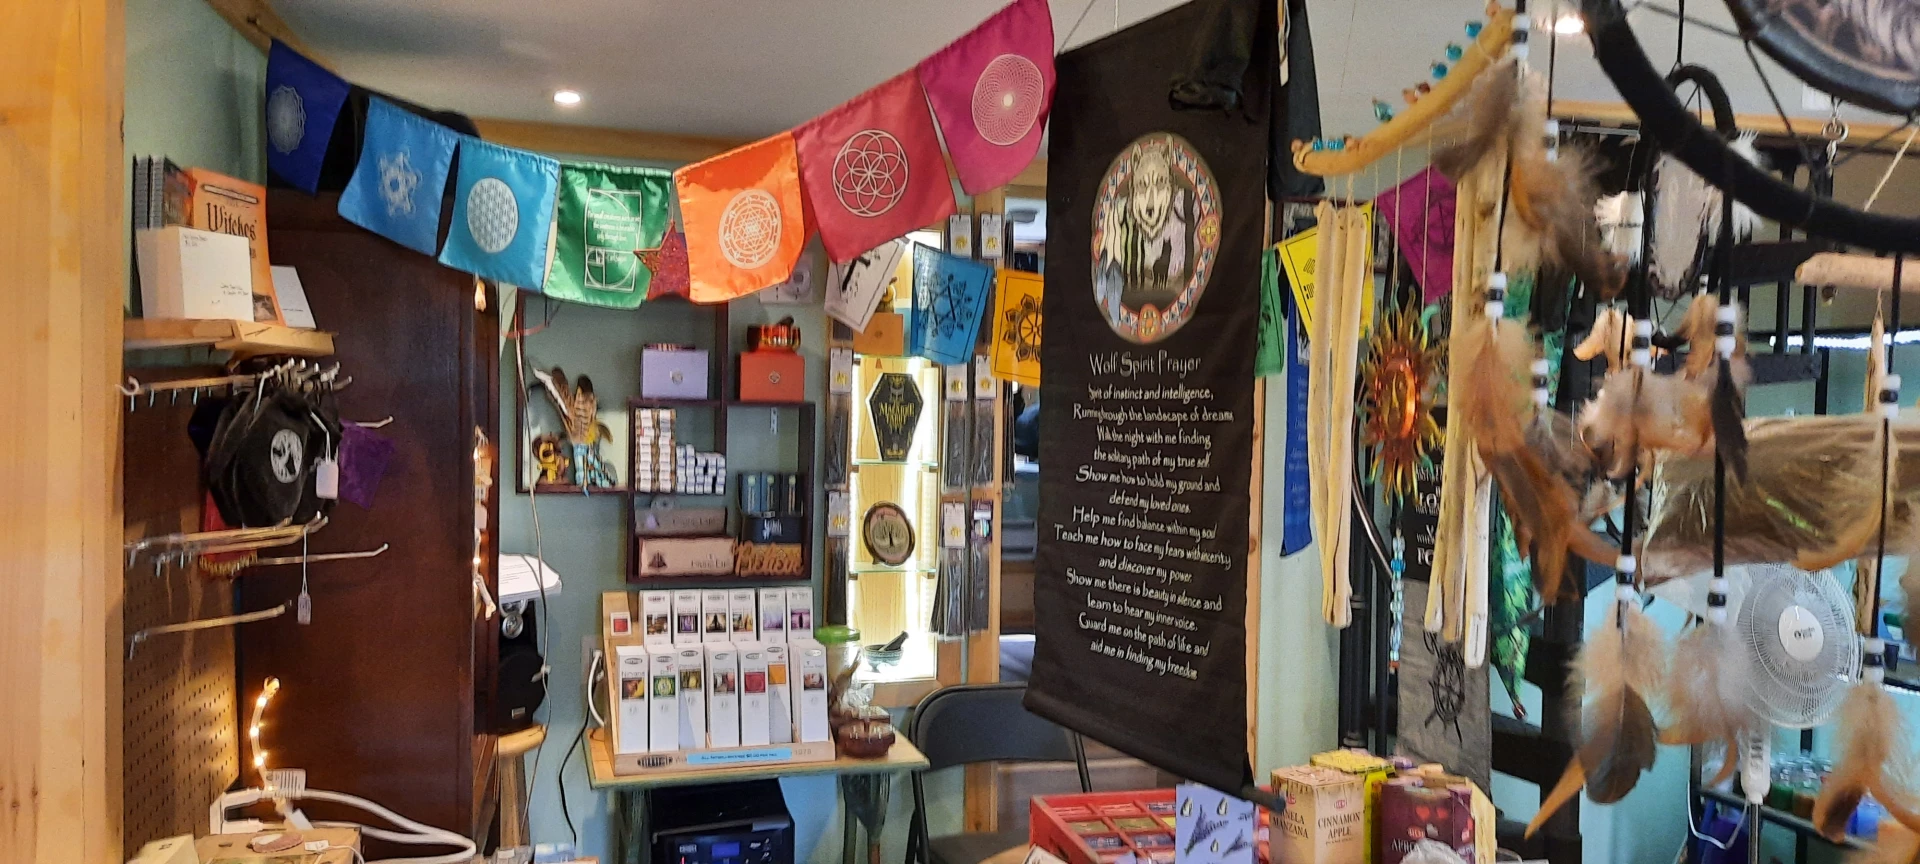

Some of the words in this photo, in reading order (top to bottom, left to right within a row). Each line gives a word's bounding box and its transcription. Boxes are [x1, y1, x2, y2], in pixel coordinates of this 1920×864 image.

[1089, 351, 1118, 376] Wolf
[1120, 350, 1155, 381] Spirit
[1158, 349, 1201, 379] Prayer
[1103, 383, 1113, 400] of
[1113, 386, 1143, 400] instinct
[1143, 382, 1161, 400] and
[1161, 382, 1214, 405] intelligence,
[1128, 405, 1143, 421] the
[1142, 405, 1189, 427] landscape
[1190, 405, 1200, 421] of
[1111, 426, 1123, 442] the
[1124, 427, 1145, 448] night
[1145, 427, 1164, 444] with
[1164, 434, 1177, 444] me
[1178, 427, 1212, 450] finding
[1093, 444, 1107, 461] the
[1131, 449, 1151, 470] path
[1151, 449, 1162, 466] of
[1162, 456, 1176, 473] my
[1176, 454, 1196, 468] true
[1075, 464, 1109, 483] Show
[1109, 473, 1121, 483] me
[1136, 474, 1146, 486] to
[1145, 471, 1165, 488] hold
[1165, 479, 1178, 495] my
[1176, 473, 1204, 495] ground
[1203, 475, 1221, 492] and
[1108, 488, 1139, 507] defend
[1138, 498, 1150, 514] my
[1149, 493, 1172, 512] loved
[1072, 505, 1100, 528] Help
[1101, 514, 1116, 526] me
[1117, 510, 1136, 529] find
[1135, 512, 1165, 533] balance
[1166, 518, 1189, 536] within
[1189, 526, 1201, 543] my
[1053, 523, 1084, 543] Teach
[1084, 534, 1099, 546] me
[1100, 530, 1122, 548] how
[1123, 537, 1134, 550] to
[1134, 534, 1153, 554] face
[1153, 544, 1165, 561] my
[1164, 539, 1186, 559] fears
[1186, 543, 1201, 561] with
[1098, 553, 1118, 569] and
[1117, 555, 1156, 577] discover
[1156, 567, 1168, 584] my
[1066, 567, 1093, 585] Show
[1093, 578, 1107, 589] me
[1107, 574, 1132, 594] there
[1132, 581, 1141, 596] is
[1141, 580, 1169, 607] beauty
[1169, 590, 1176, 603] in
[1202, 593, 1223, 611] and
[1087, 591, 1112, 612] learn
[1112, 601, 1123, 614] to
[1123, 599, 1144, 618] hear
[1144, 610, 1155, 627] my
[1155, 609, 1175, 626] inner
[1078, 611, 1107, 632] Guard
[1108, 624, 1122, 636] me
[1122, 627, 1134, 638] on
[1133, 624, 1147, 642] the
[1147, 630, 1167, 650] path
[1167, 633, 1177, 650] of
[1177, 634, 1192, 653] life
[1193, 640, 1210, 657] and
[1090, 637, 1104, 653] aid
[1103, 645, 1116, 656] me
[1116, 645, 1125, 659] in
[1125, 644, 1154, 672] finding
[1154, 659, 1167, 676] my
[1273, 816, 1309, 839] MANZANA
[1318, 811, 1361, 829] CINNAMON
[1328, 826, 1352, 839] APPLE
